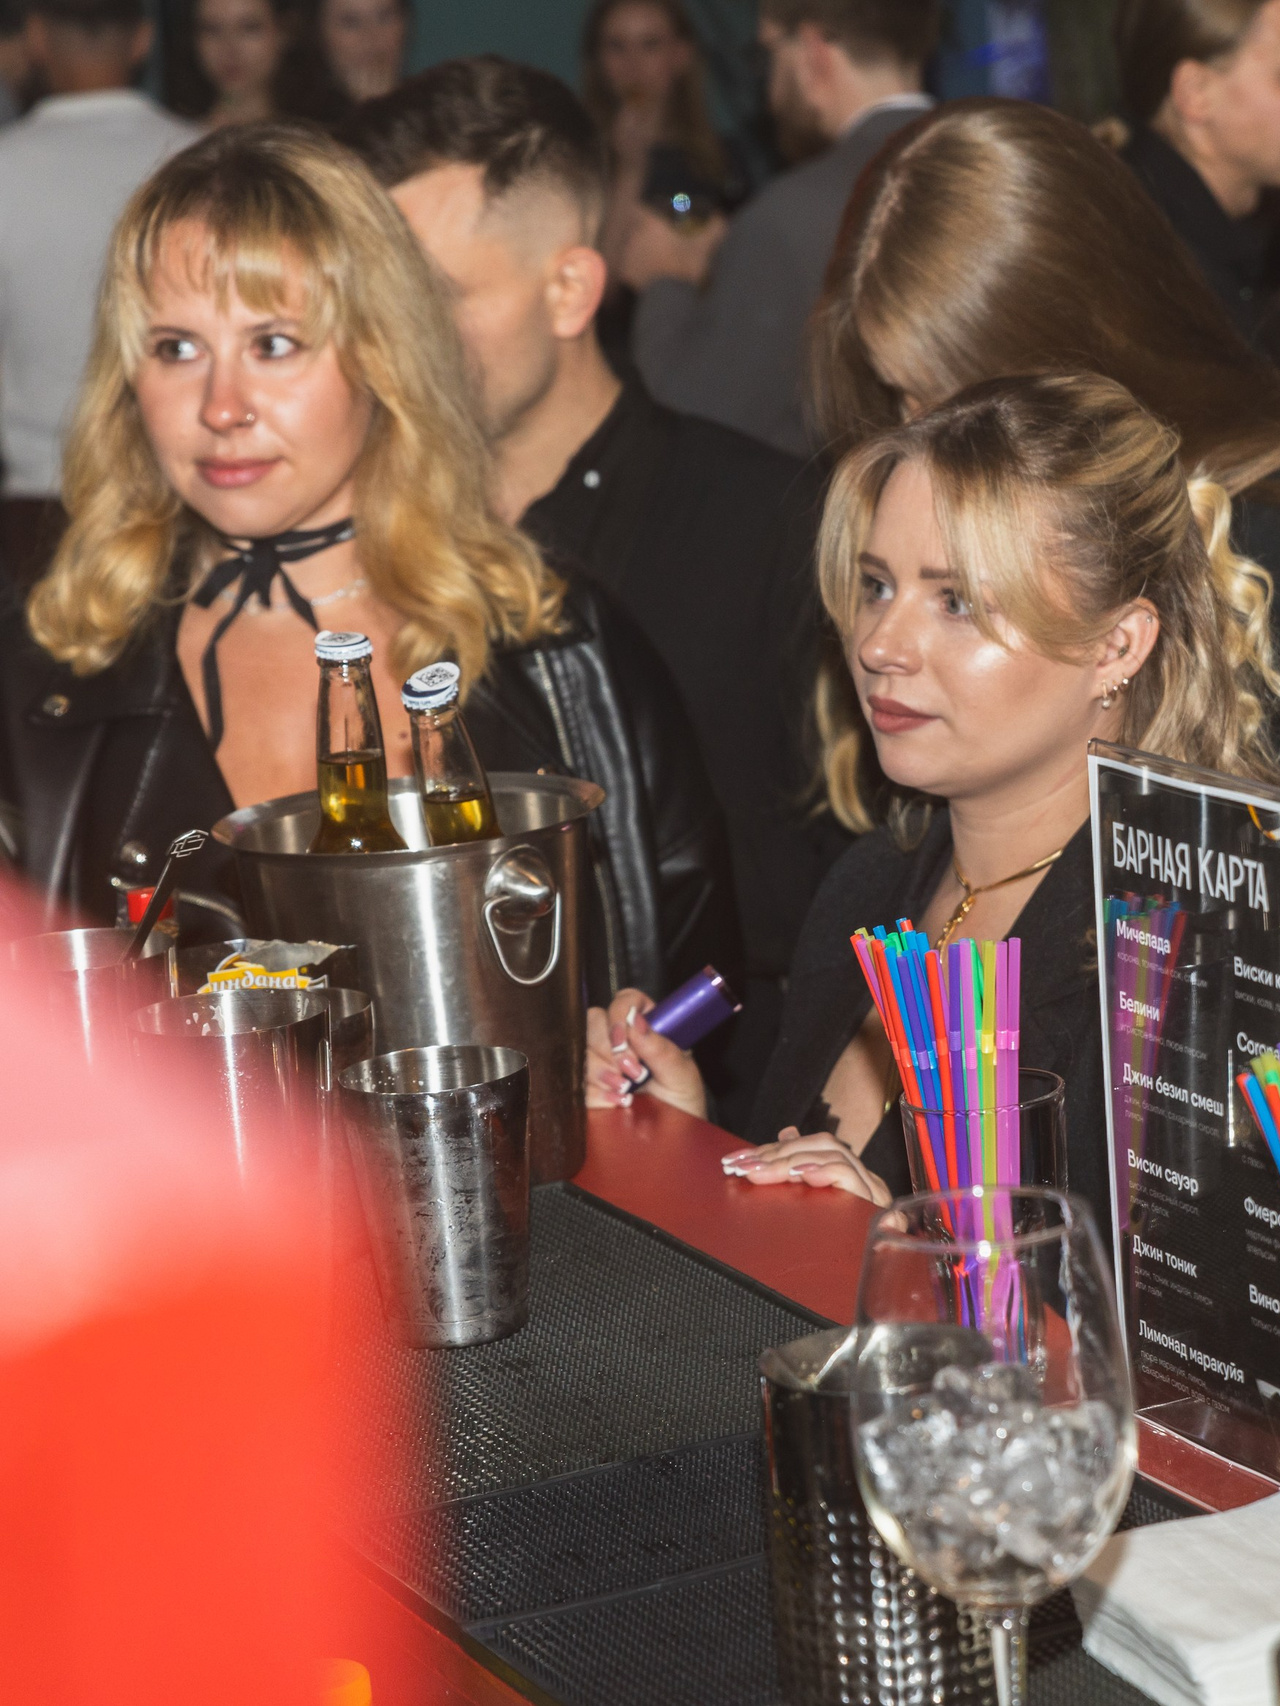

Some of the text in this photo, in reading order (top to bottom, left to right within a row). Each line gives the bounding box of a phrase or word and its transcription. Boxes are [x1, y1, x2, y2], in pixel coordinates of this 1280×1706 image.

[1112, 821, 1270, 912] БАРНАЯ КАРТА
[1116, 918, 1171, 956] Мичелада
[1233, 955, 1274, 987] Виски
[1119, 990, 1160, 1022] Белини
[1123, 1062, 1225, 1117] Джин безил смеш
[1127, 1148, 1199, 1197] Виски сауэр
[1132, 1234, 1198, 1279] Джин тоник
[1248, 1283, 1280, 1314] Вино
[1139, 1318, 1246, 1384] Лимонад маракуйя
